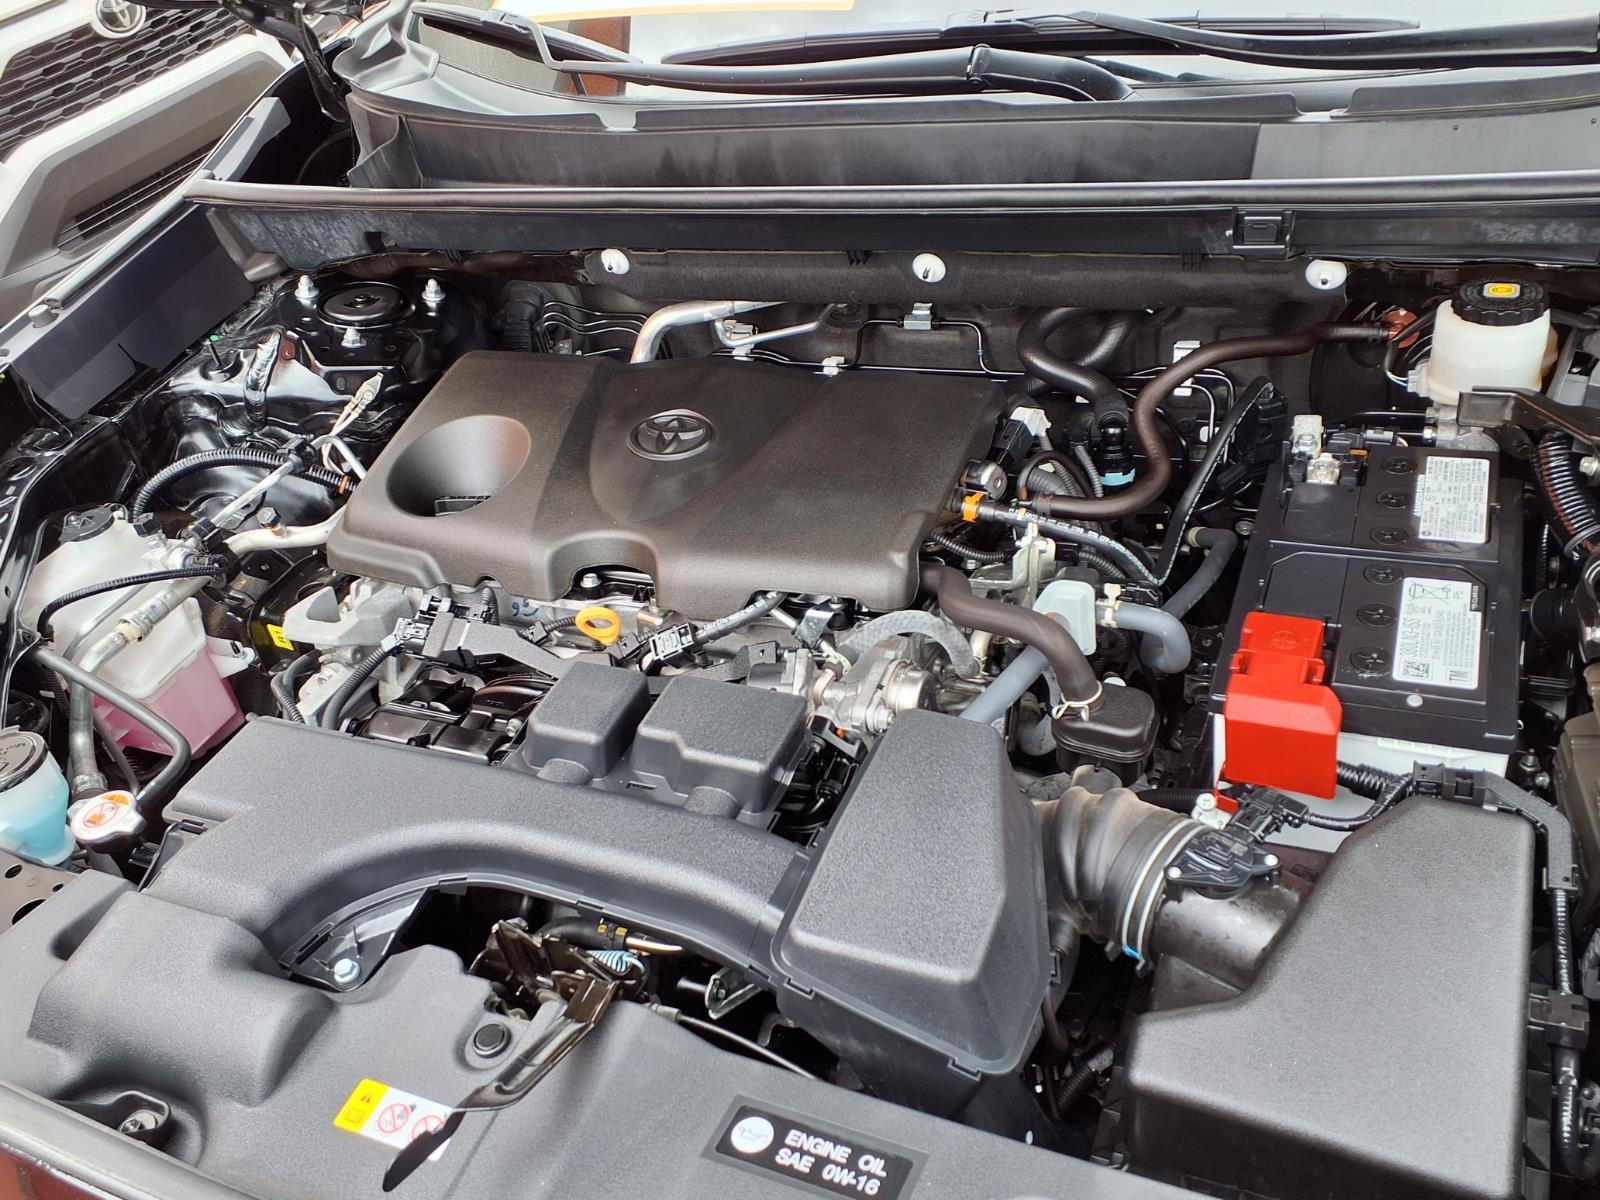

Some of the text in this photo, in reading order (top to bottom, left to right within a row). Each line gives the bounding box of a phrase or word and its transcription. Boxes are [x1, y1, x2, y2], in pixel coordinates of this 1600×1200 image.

[775, 1148, 881, 1195] SAE 0W-16
[784, 1129, 887, 1177] ENGINE OIL
